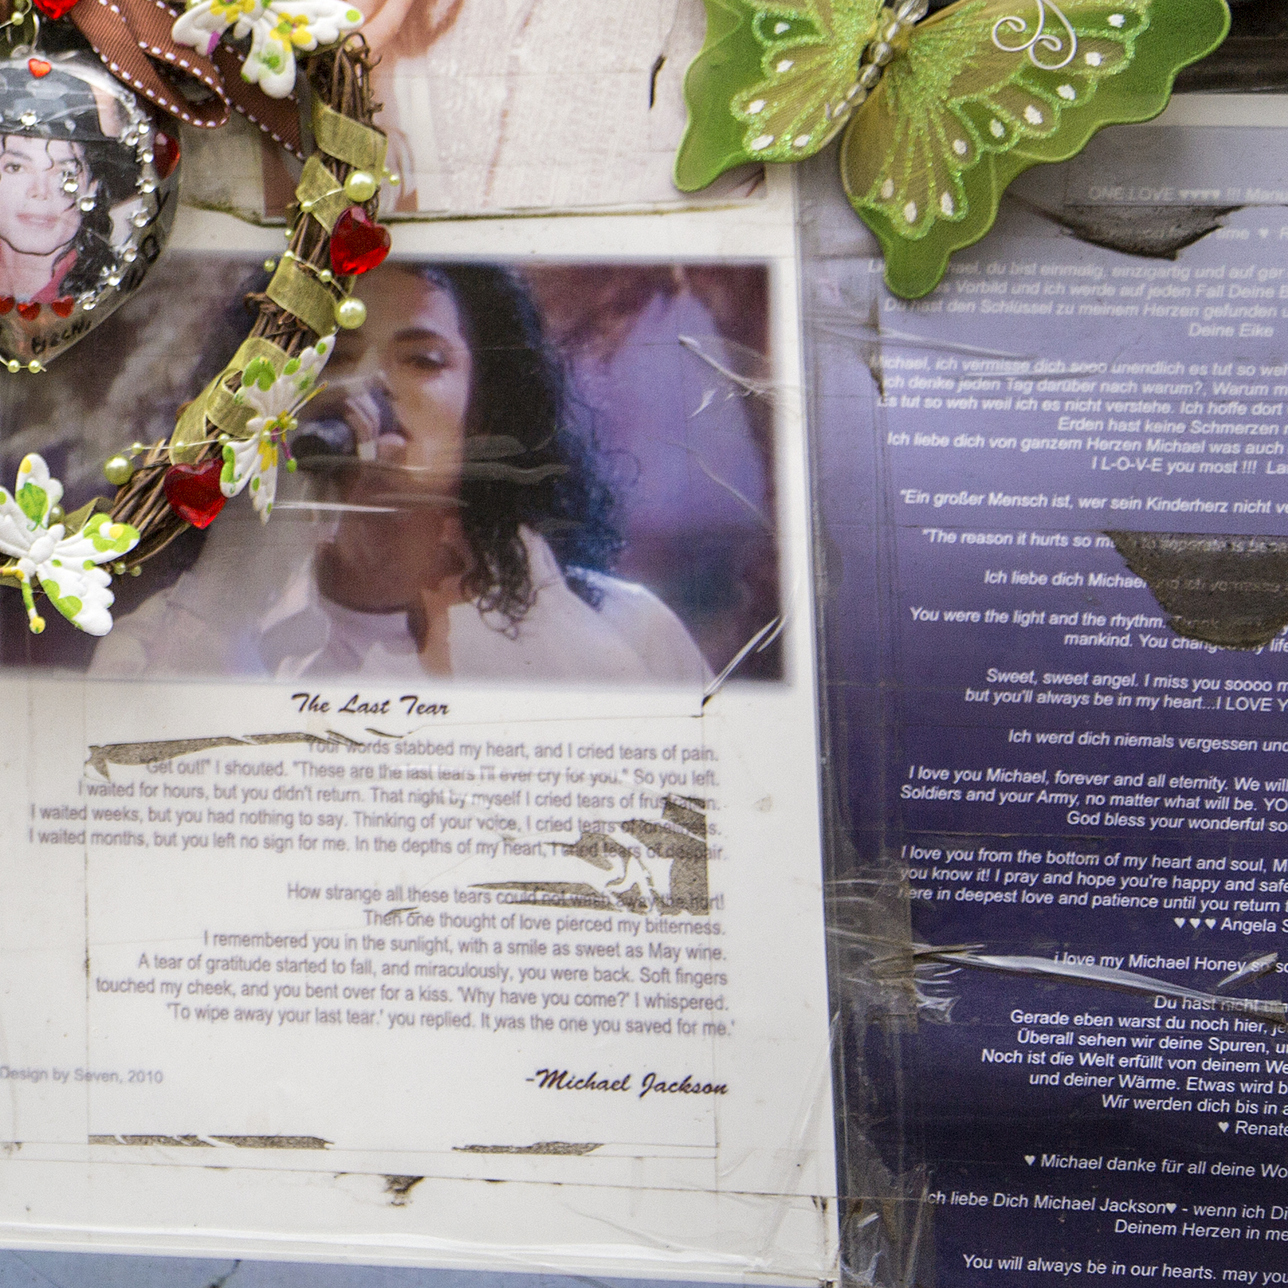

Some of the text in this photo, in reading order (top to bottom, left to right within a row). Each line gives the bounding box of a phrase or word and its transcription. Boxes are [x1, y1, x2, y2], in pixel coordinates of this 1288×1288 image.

[290, 691, 450, 716] The Last Tear
[204, 930, 725, 961] I remembered you in the sunlight, with a smile as sweet as May wine.
[97, 978, 154, 993] touched
[161, 982, 181, 997] my
[188, 981, 235, 995] cheek,
[242, 983, 268, 995] and
[275, 986, 299, 999] you
[306, 985, 337, 997] bent
[344, 988, 375, 999] over
[381, 985, 399, 999] for
[405, 988, 414, 1001] a
[420, 987, 451, 1001] kiss.
[501, 990, 536, 1004] have
[543, 994, 569, 1008] you
[635, 992, 639, 1007] I
[645, 994, 727, 1011] whispered.
[1017, 1028, 1270, 1054] Überall sehen wir deine Spuren,
[981, 1048, 1260, 1072] Noch ist die Welt erfüllt von deinem
[0, 1065, 163, 1083] Design by Seven, 2010
[639, 1073, 729, 1099] Jackson
[1029, 1072, 1273, 1094] und deiner Wärme. Etwas wird
[1102, 1094, 1277, 1114] Wir werden dich bis in
[1041, 1154, 1255, 1177] Michael danke für all deine
[963, 1254, 993, 1269] You
[998, 1256, 1023, 1270] will
[1027, 1257, 1082, 1276] always
[1087, 1260, 1107, 1274] be
[1111, 1261, 1126, 1275] in
[1130, 1265, 1158, 1276] our
[1162, 1263, 1215, 1279] hearts.
[1222, 1270, 1258, 1285] may
